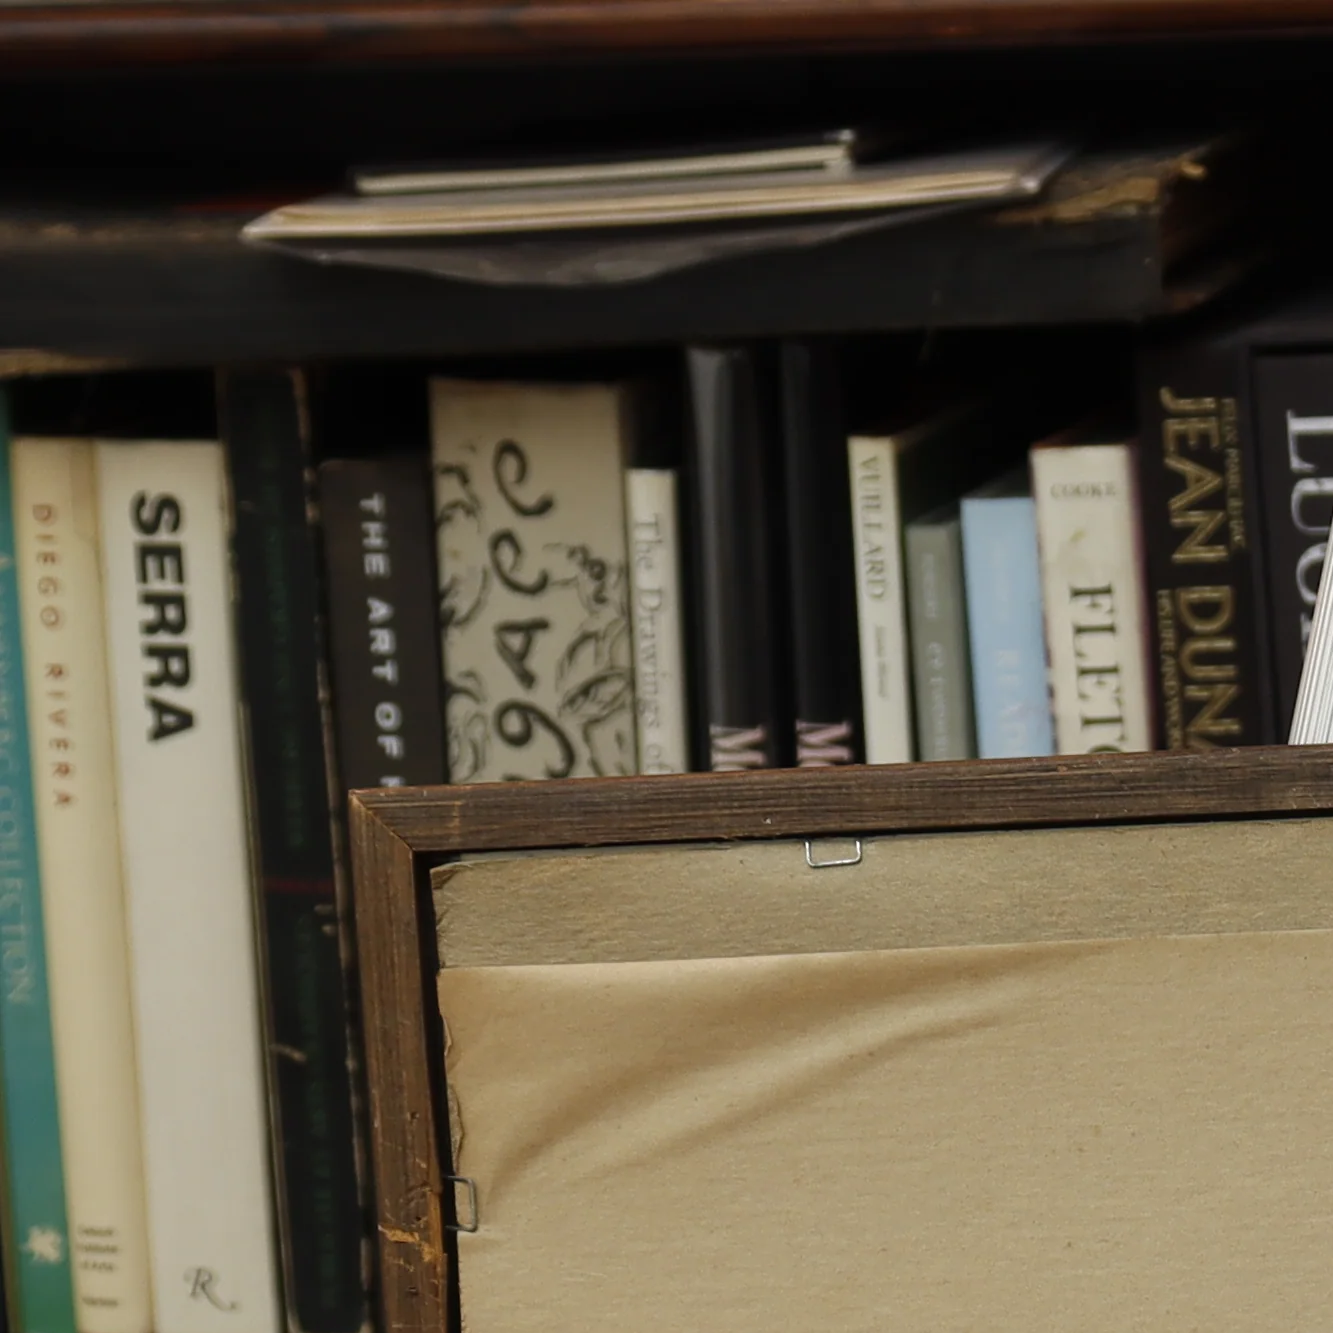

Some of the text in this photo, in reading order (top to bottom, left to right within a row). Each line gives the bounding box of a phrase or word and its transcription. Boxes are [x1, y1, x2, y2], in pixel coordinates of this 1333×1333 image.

[1050, 481, 1117, 500] COOKE
[1159, 386, 1230, 564] JEAN
[360, 492, 390, 578] THE
[634, 511, 665, 571] The
[857, 453, 890, 604] VUILLARD
[33, 503, 76, 809] DIEGO RIVERA
[131, 489, 197, 745] SERRA
[366, 597, 398, 686] ART
[636, 586, 668, 730] Drawings
[374, 701, 405, 759] OF
[709, 721, 768, 771] M
[796, 718, 854, 767] M
